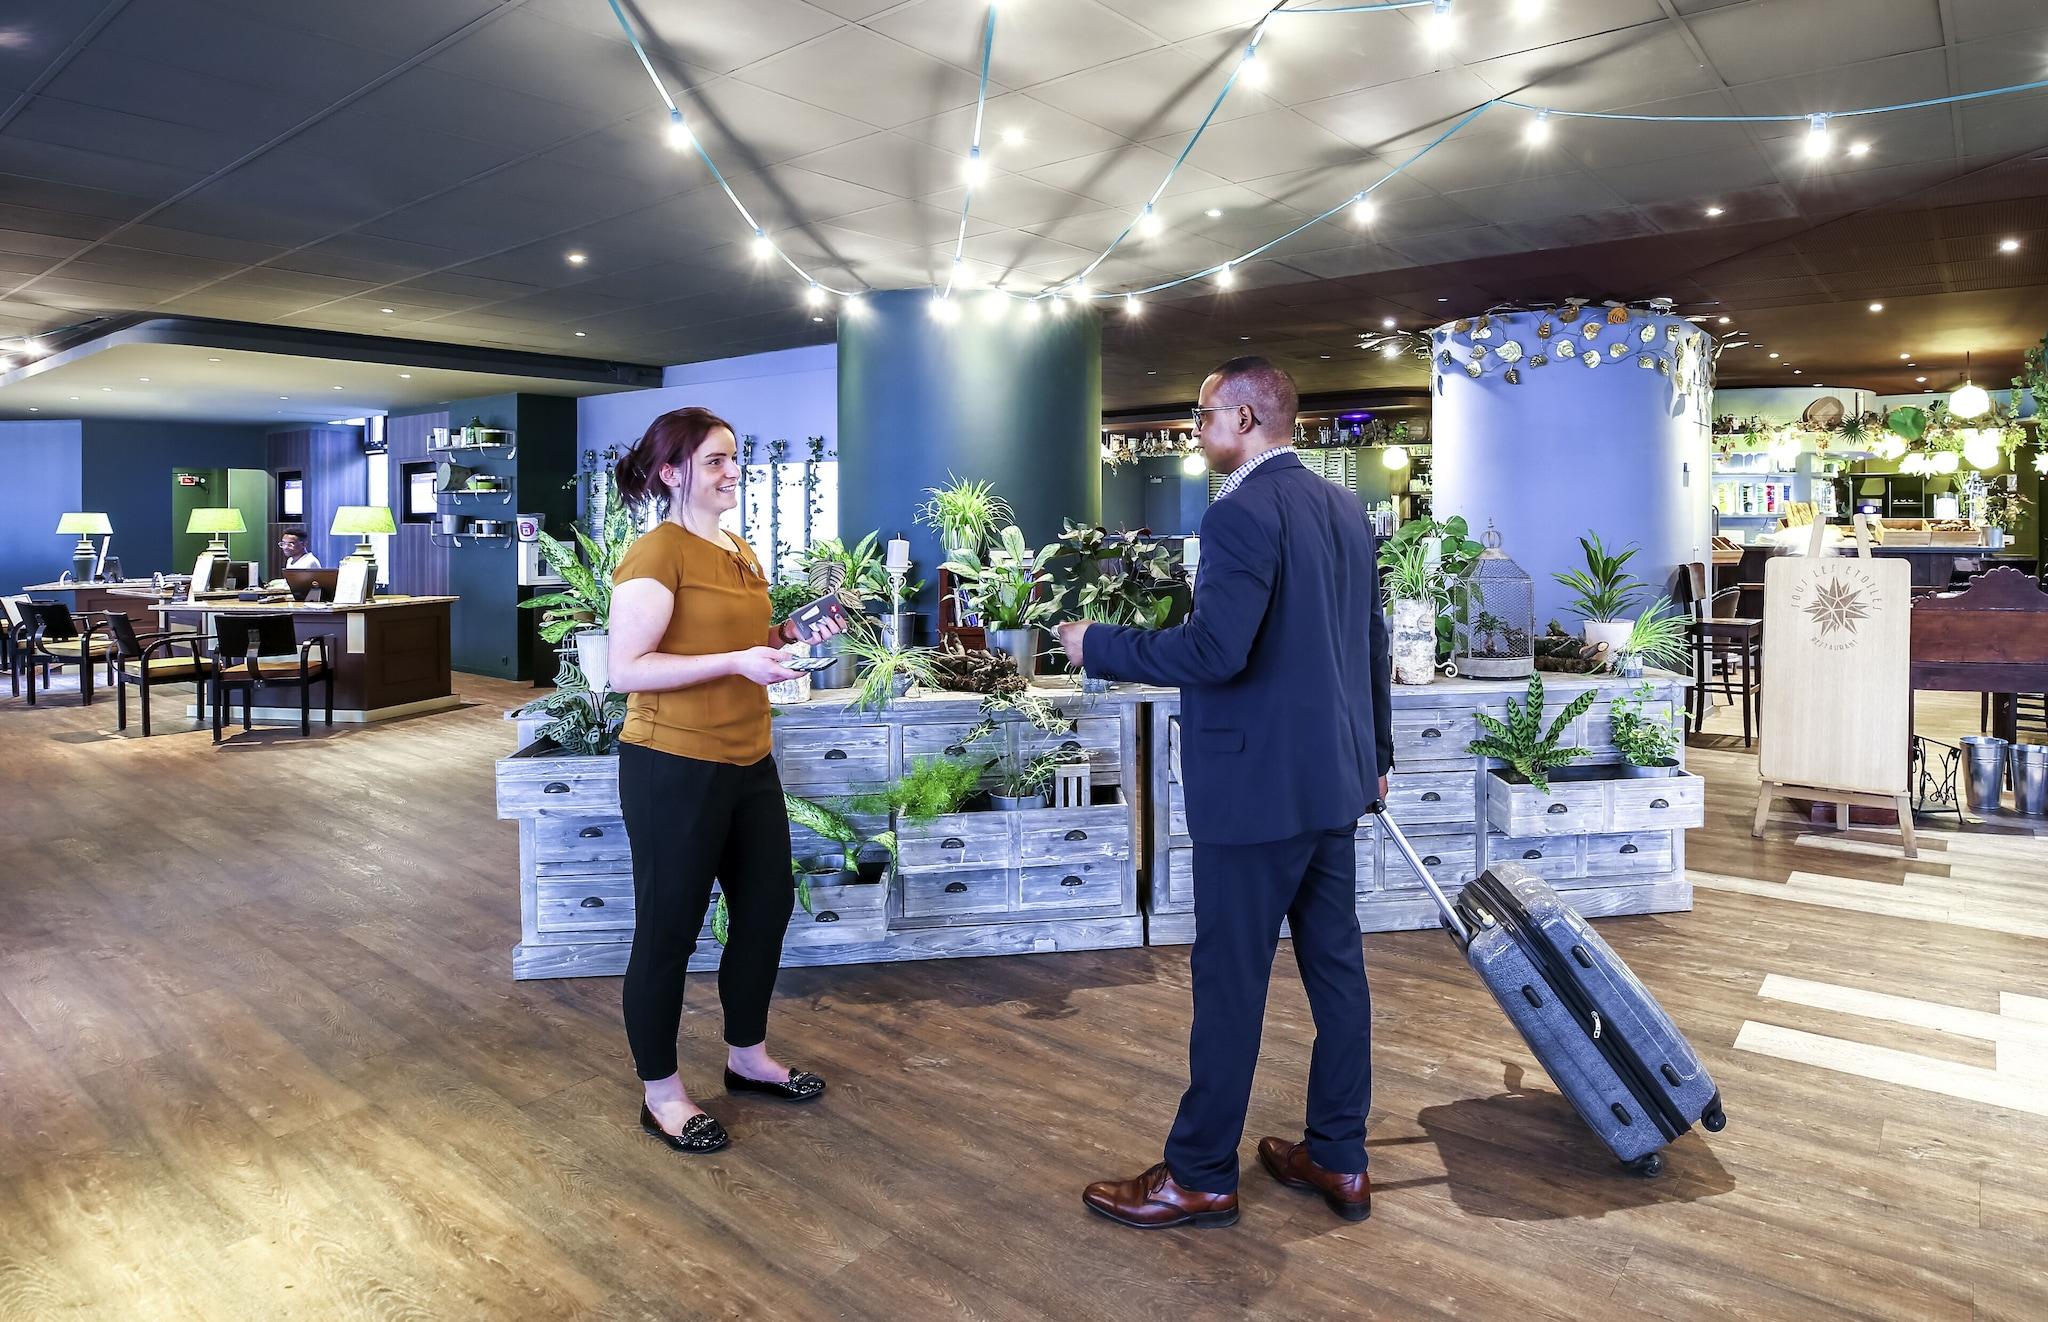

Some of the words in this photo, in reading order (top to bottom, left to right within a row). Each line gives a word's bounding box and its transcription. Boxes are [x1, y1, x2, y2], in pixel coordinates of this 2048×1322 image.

[1791, 577, 1809, 609] SOUS
[1845, 565, 1883, 612] ETOILES
[1811, 635, 1858, 651] RESTAURANT
